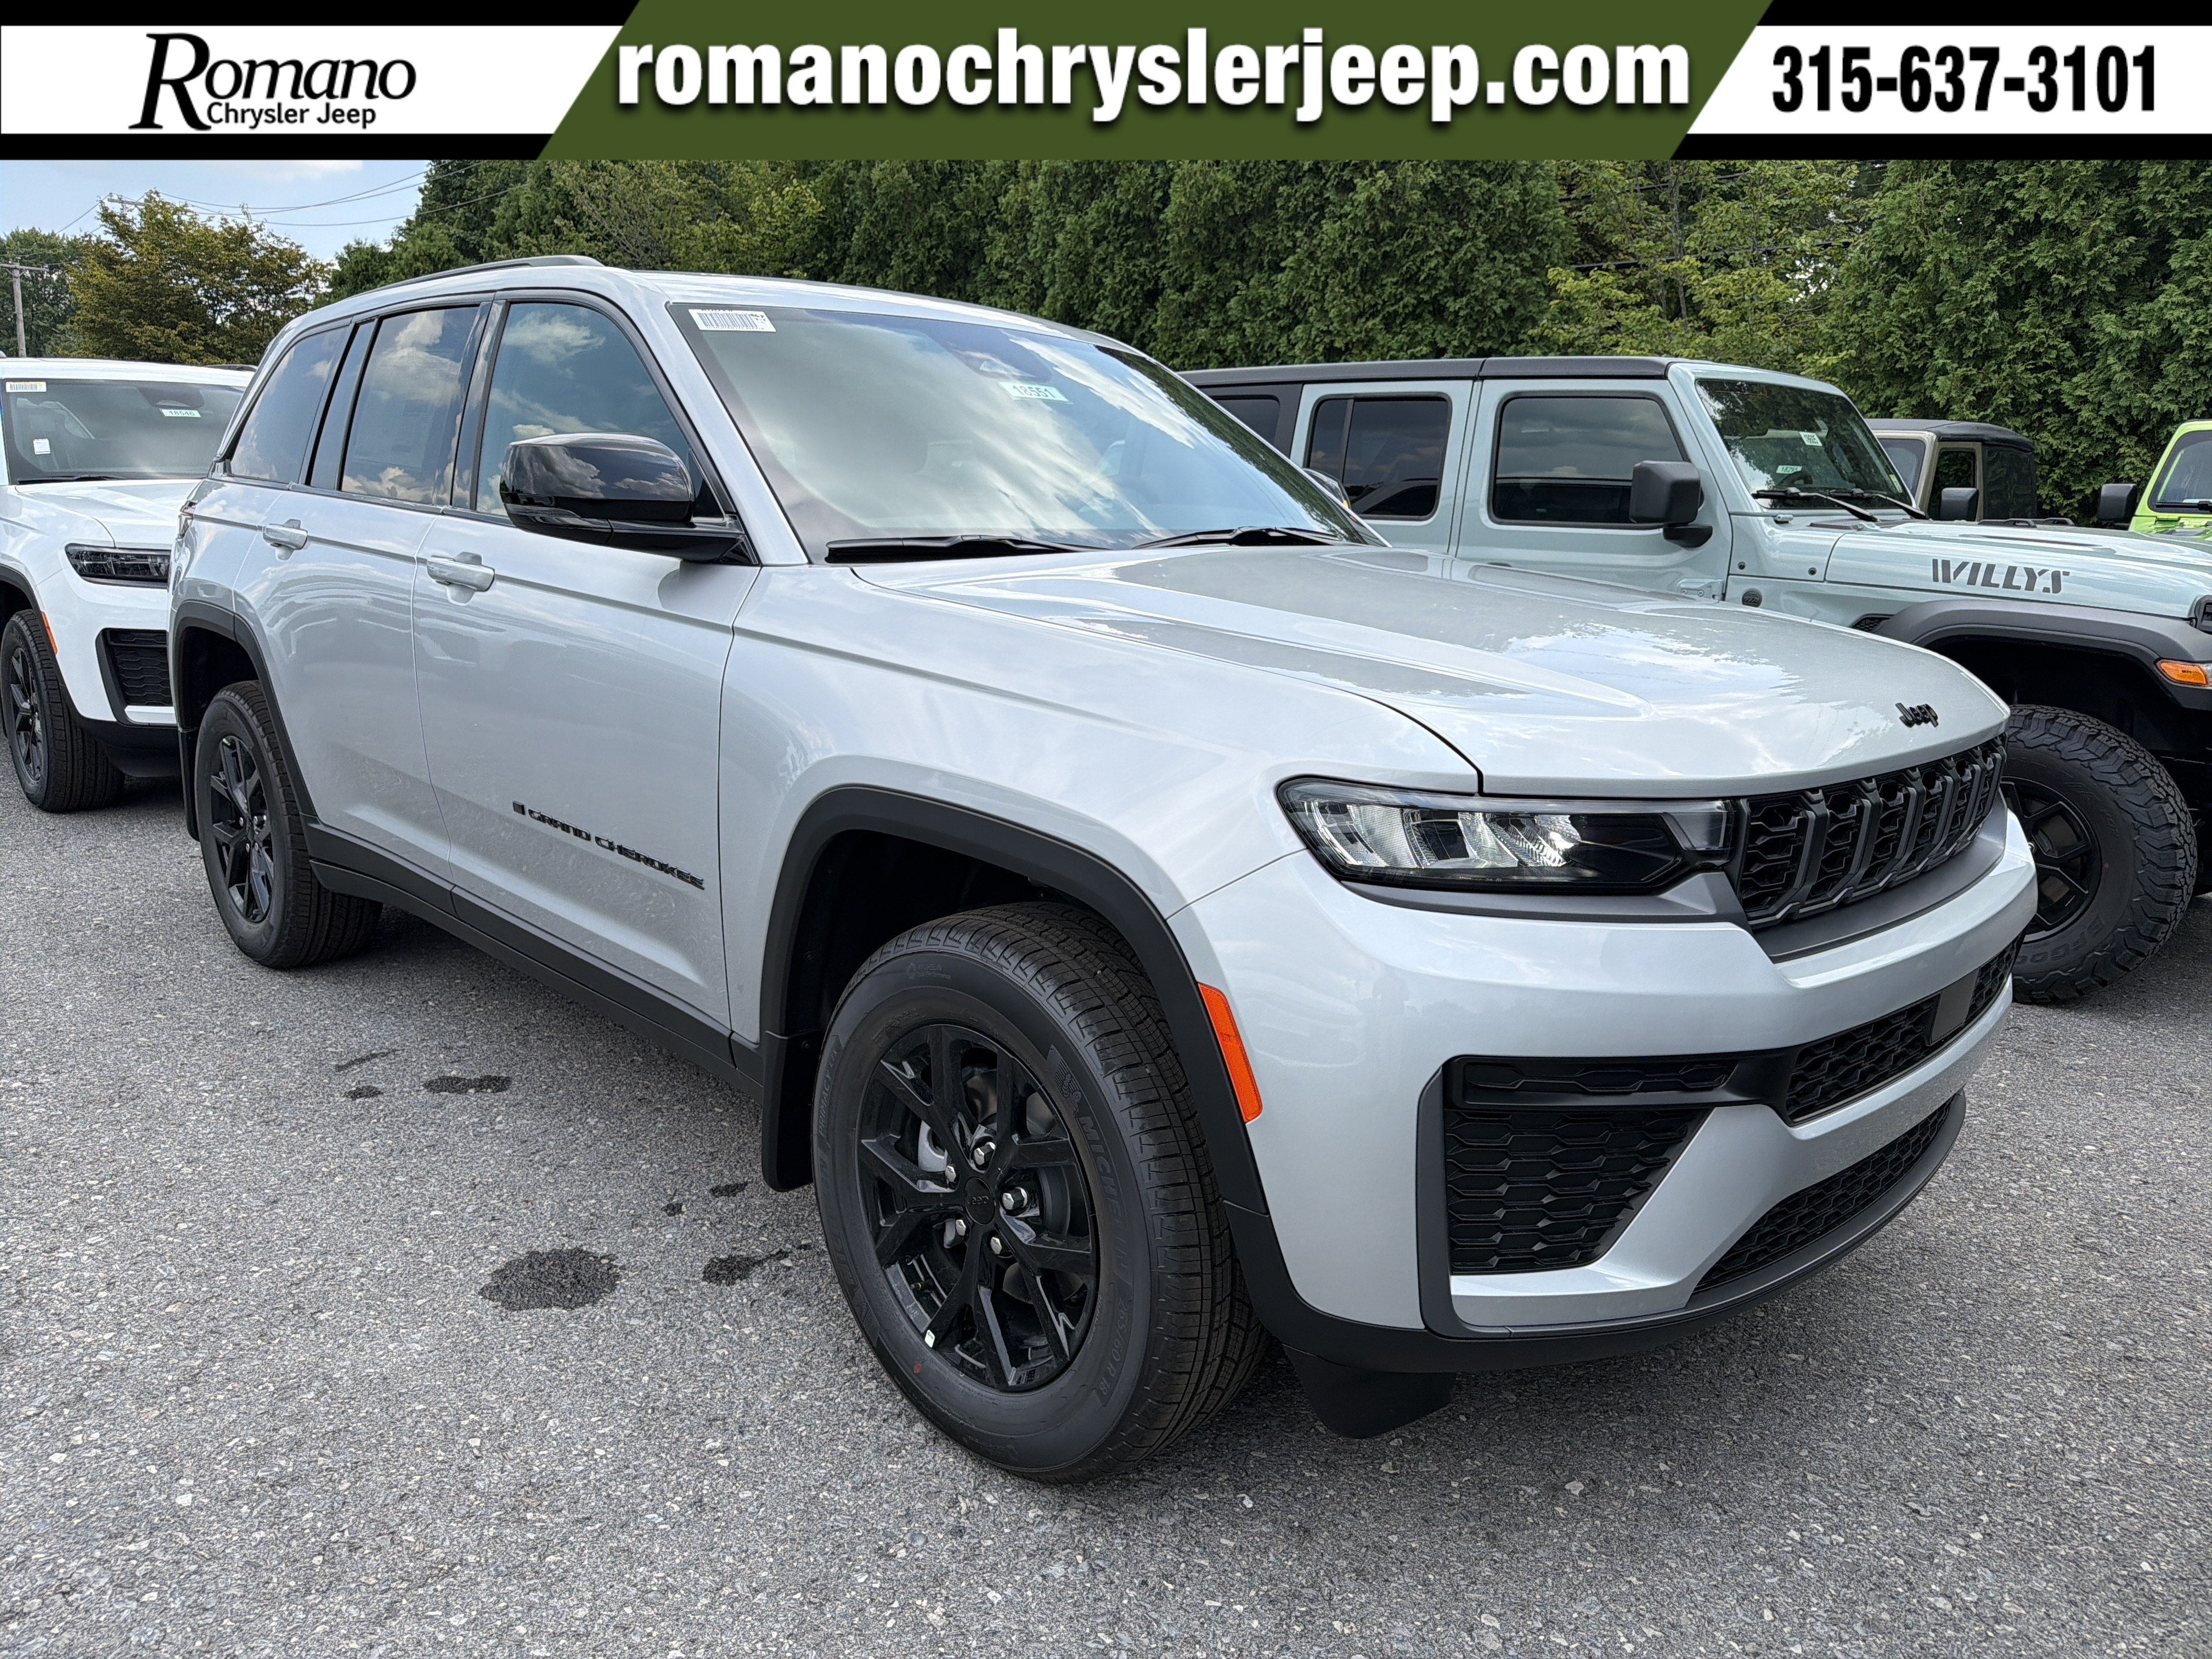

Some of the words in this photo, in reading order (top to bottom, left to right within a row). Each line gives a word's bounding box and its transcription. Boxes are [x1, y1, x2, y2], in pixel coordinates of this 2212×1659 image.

[1013, 385, 1056, 398] 18551
[1932, 558, 2070, 594] WILLYS
[1895, 702, 1939, 728] Jeep
[528, 808, 591, 841] GRAND
[595, 836, 705, 890] CHEROKEE
